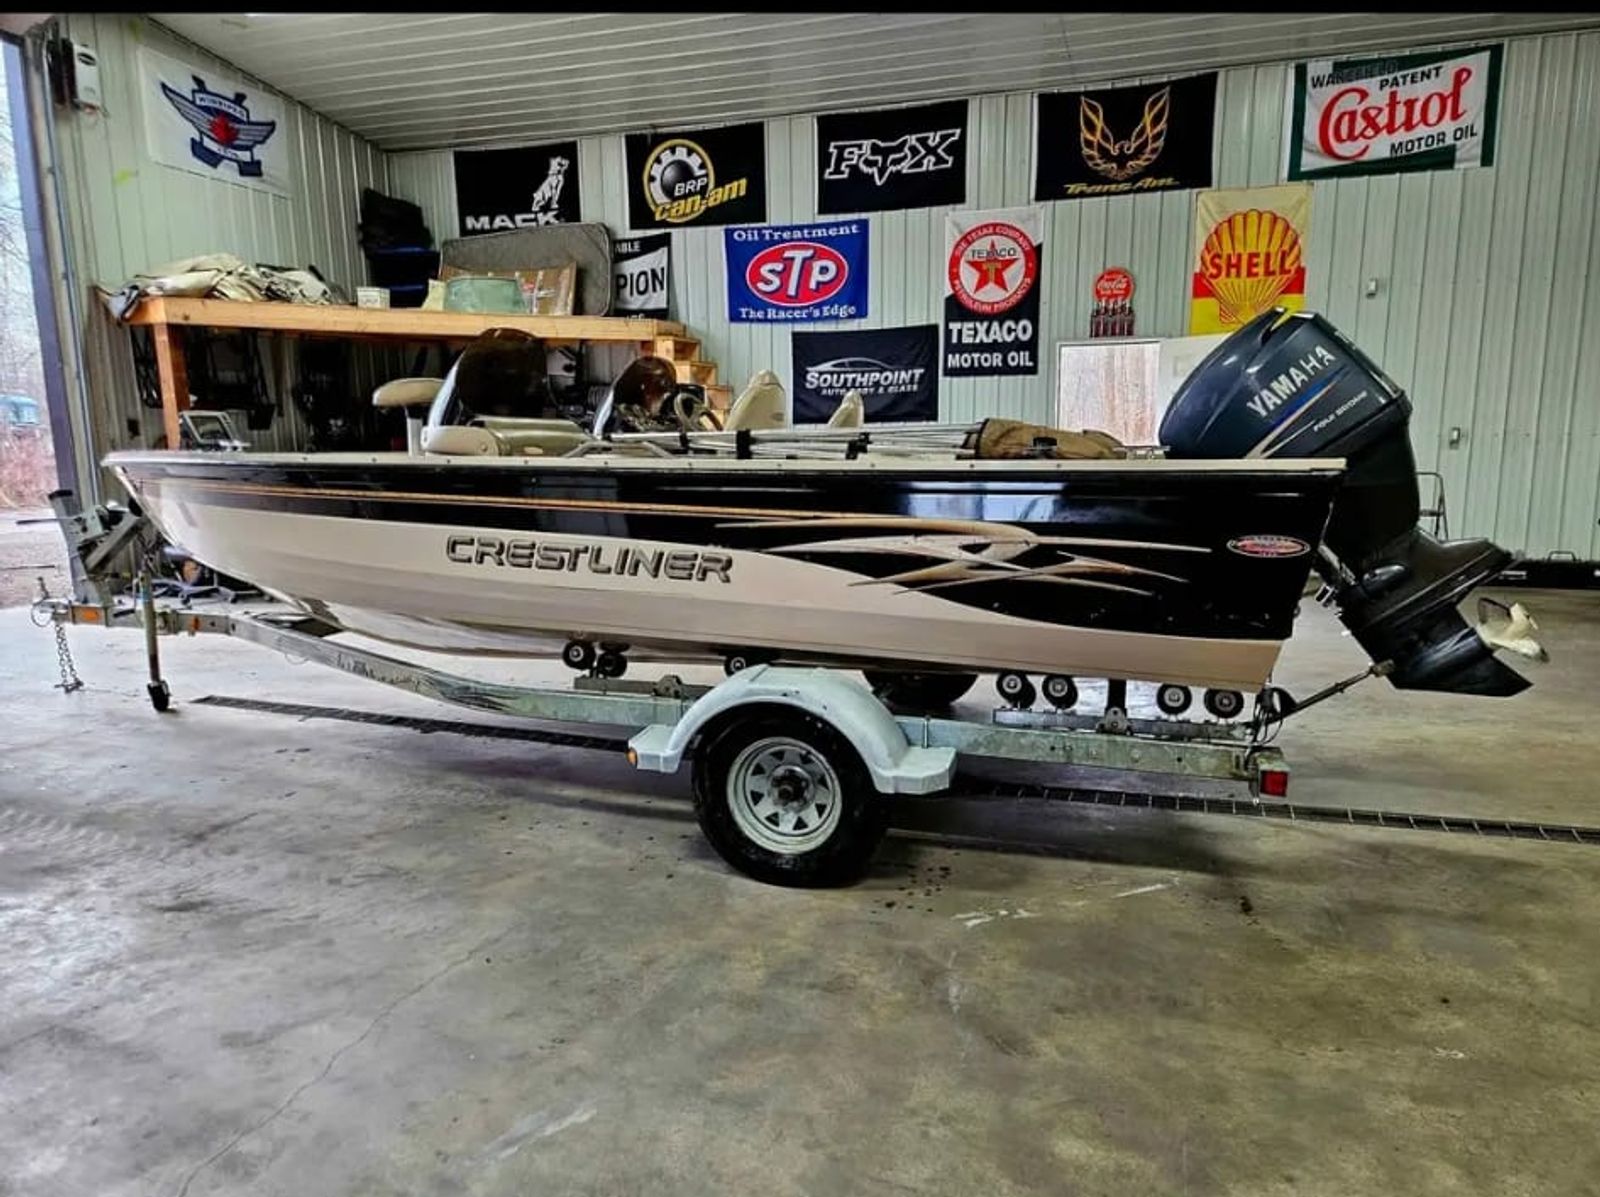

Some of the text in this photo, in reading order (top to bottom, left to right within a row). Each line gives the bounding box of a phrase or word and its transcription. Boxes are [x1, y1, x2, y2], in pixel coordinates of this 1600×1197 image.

[1379, 65, 1443, 91] PATENT
[1319, 67, 1472, 161] Castrol
[1390, 124, 1478, 159] MOTOR OIL
[674, 177, 707, 197] BRP
[465, 211, 561, 230] MACK
[733, 224, 860, 241] Oil Treatment
[615, 240, 641, 253] ABLE
[971, 247, 1017, 258] TEXACO
[757, 249, 837, 297] STP
[1207, 249, 1292, 279] SHELL
[616, 267, 664, 299] PION
[739, 304, 856, 319] The Racer's Edge
[948, 319, 1033, 344] TEXACO
[947, 351, 1034, 368] MOTOR OIL
[805, 369, 925, 389] SOUTHPOINT
[1246, 345, 1337, 418] YAMAHA
[446, 534, 733, 583] CRESTLINER
